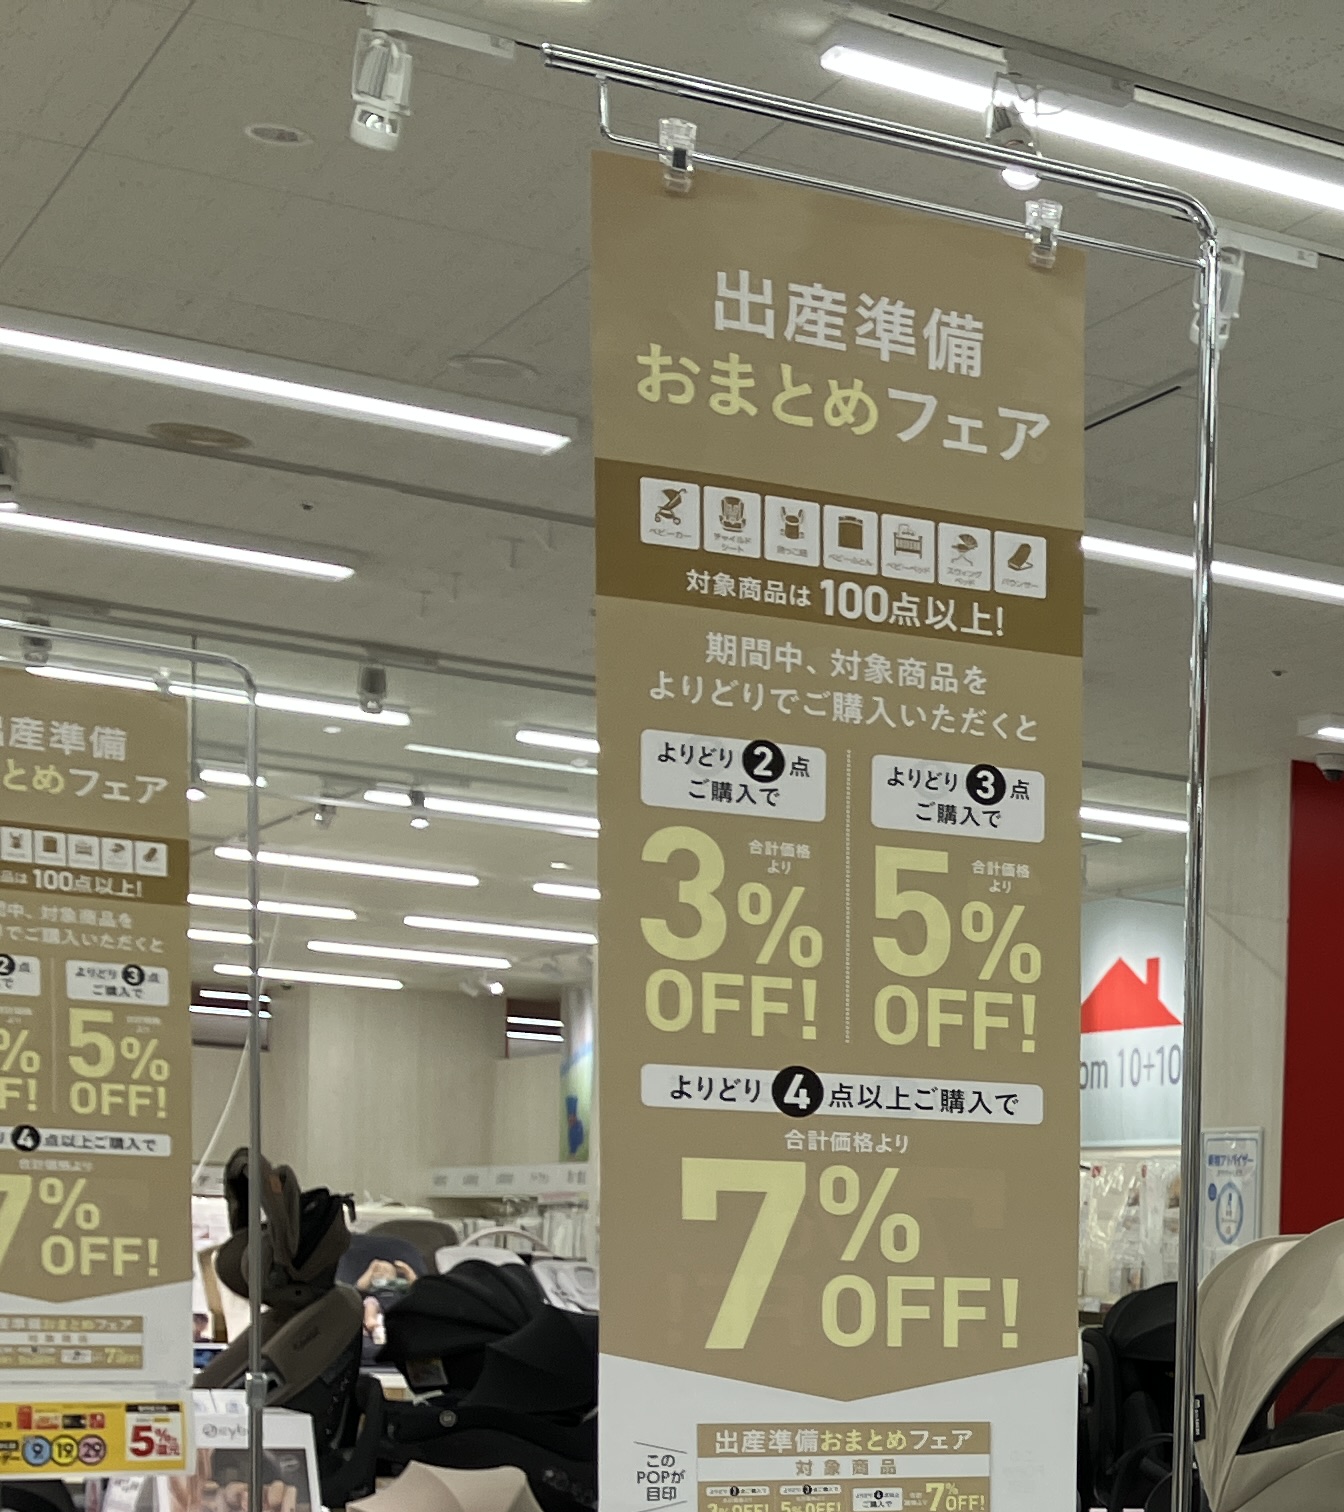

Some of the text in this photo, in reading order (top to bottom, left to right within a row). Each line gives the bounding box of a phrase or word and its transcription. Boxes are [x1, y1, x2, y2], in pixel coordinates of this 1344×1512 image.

[714, 270, 984, 378] 出産準備
[637, 343, 1050, 460] おまとめフェア
[705, 632, 987, 695] 期間中、対象商品を
[649, 671, 1038, 742] よりどりでご購入いただくと
[0, 716, 127, 761] 産準備
[3, 759, 168, 804] とめフェア
[689, 779, 780, 807] ご購入で
[916, 802, 1002, 828] ご購入で
[748, 839, 811, 860] 合計価格
[767, 859, 792, 876] より
[971, 860, 1031, 880] 合計価格
[988, 878, 1012, 894] より
[645, 967, 817, 1041] OFF!
[873, 983, 1039, 1055] OFF!
[69, 1080, 168, 1119] OFF!
[669, 1073, 1020, 1116] よりどり4点以上ご購入で
[783, 1129, 909, 1154] 合計価格より
[40, 1235, 159, 1278] OFF!
[821, 1274, 1019, 1349] OFF!
[715, 1428, 974, 1454] 出産準備おまとめフェア
[637, 1469, 686, 1486] POPが
[646, 1454, 676, 1468] この
[795, 1458, 898, 1476] 対象商品
[646, 1486, 677, 1502] 目印
